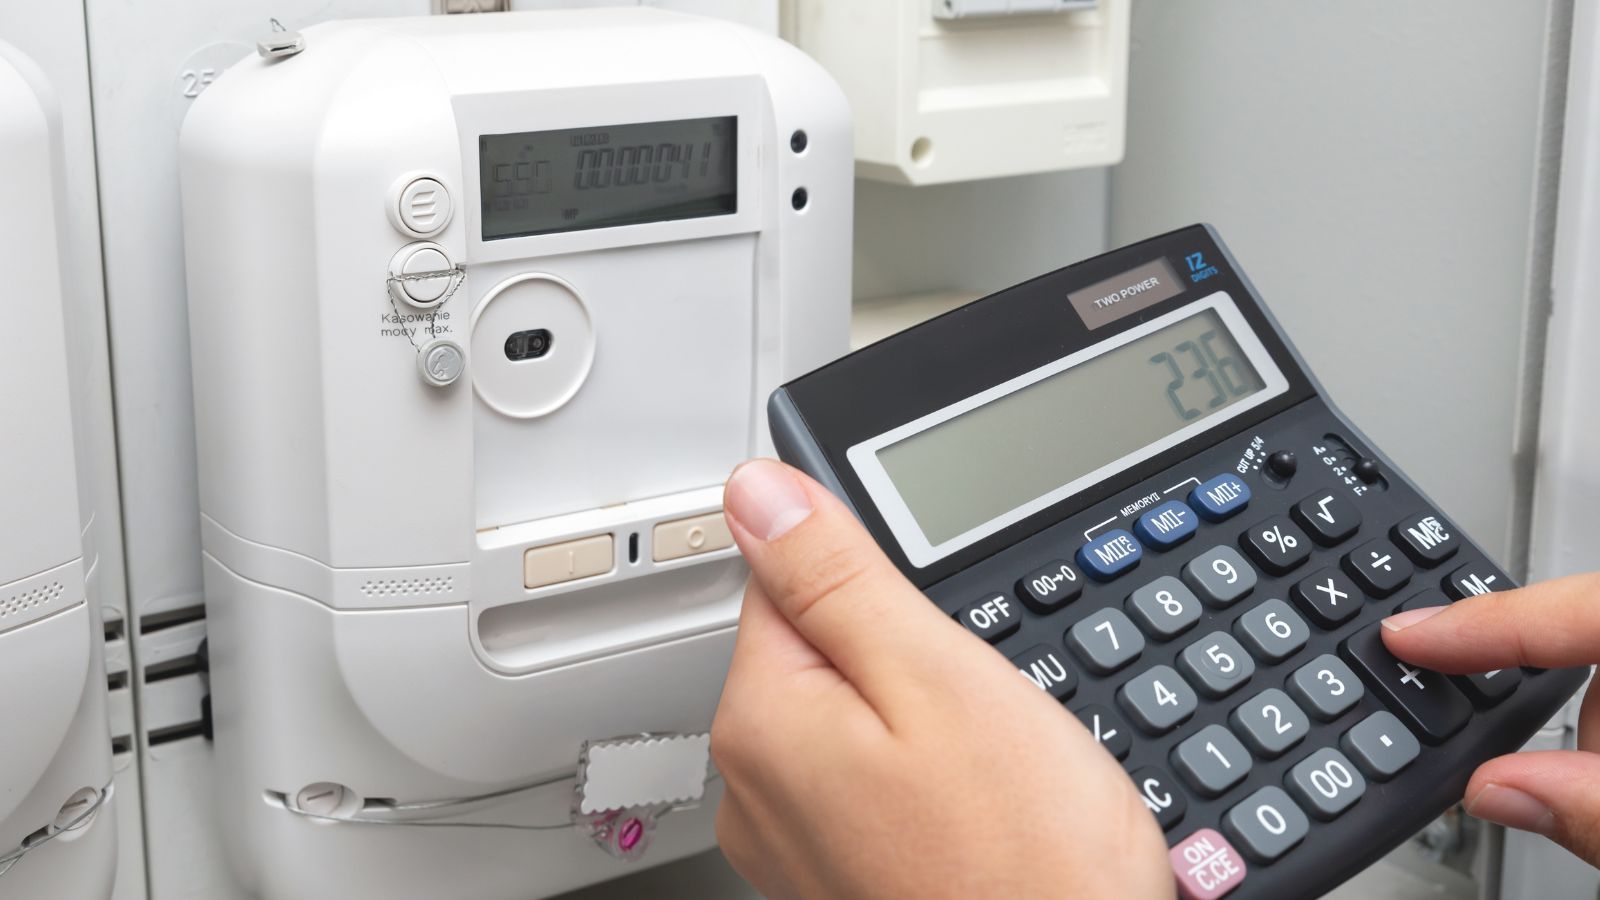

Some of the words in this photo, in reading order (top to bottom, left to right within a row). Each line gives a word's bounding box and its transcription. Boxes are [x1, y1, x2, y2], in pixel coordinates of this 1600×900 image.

[1191, 266, 1218, 283] DIGITS
[1094, 292, 1121, 309] TWO
[1121, 277, 1160, 299] POWER
[381, 311, 450, 324] Kasowanie
[381, 327, 417, 338] mocy
[424, 324, 453, 335] max.
[1149, 329, 1248, 421] 236
[1236, 457, 1249, 474] CUT
[1244, 449, 1255, 460] UP
[1251, 435, 1264, 450] 5/4
[1212, 559, 1238, 584] 9
[970, 595, 1010, 629] OFF
[1156, 591, 1183, 616] 8
[1094, 620, 1120, 650] 7
[1265, 612, 1292, 638] 6
[1206, 644, 1235, 673] 5
[1153, 680, 1178, 706] 4
[1317, 669, 1345, 696] 3
[1262, 704, 1292, 735] 2
[1206, 741, 1231, 769] 1
[1310, 760, 1353, 798] 00
[1256, 804, 1286, 835] 0
[1183, 837, 1215, 862] ON
[1195, 852, 1240, 891] C.CE
